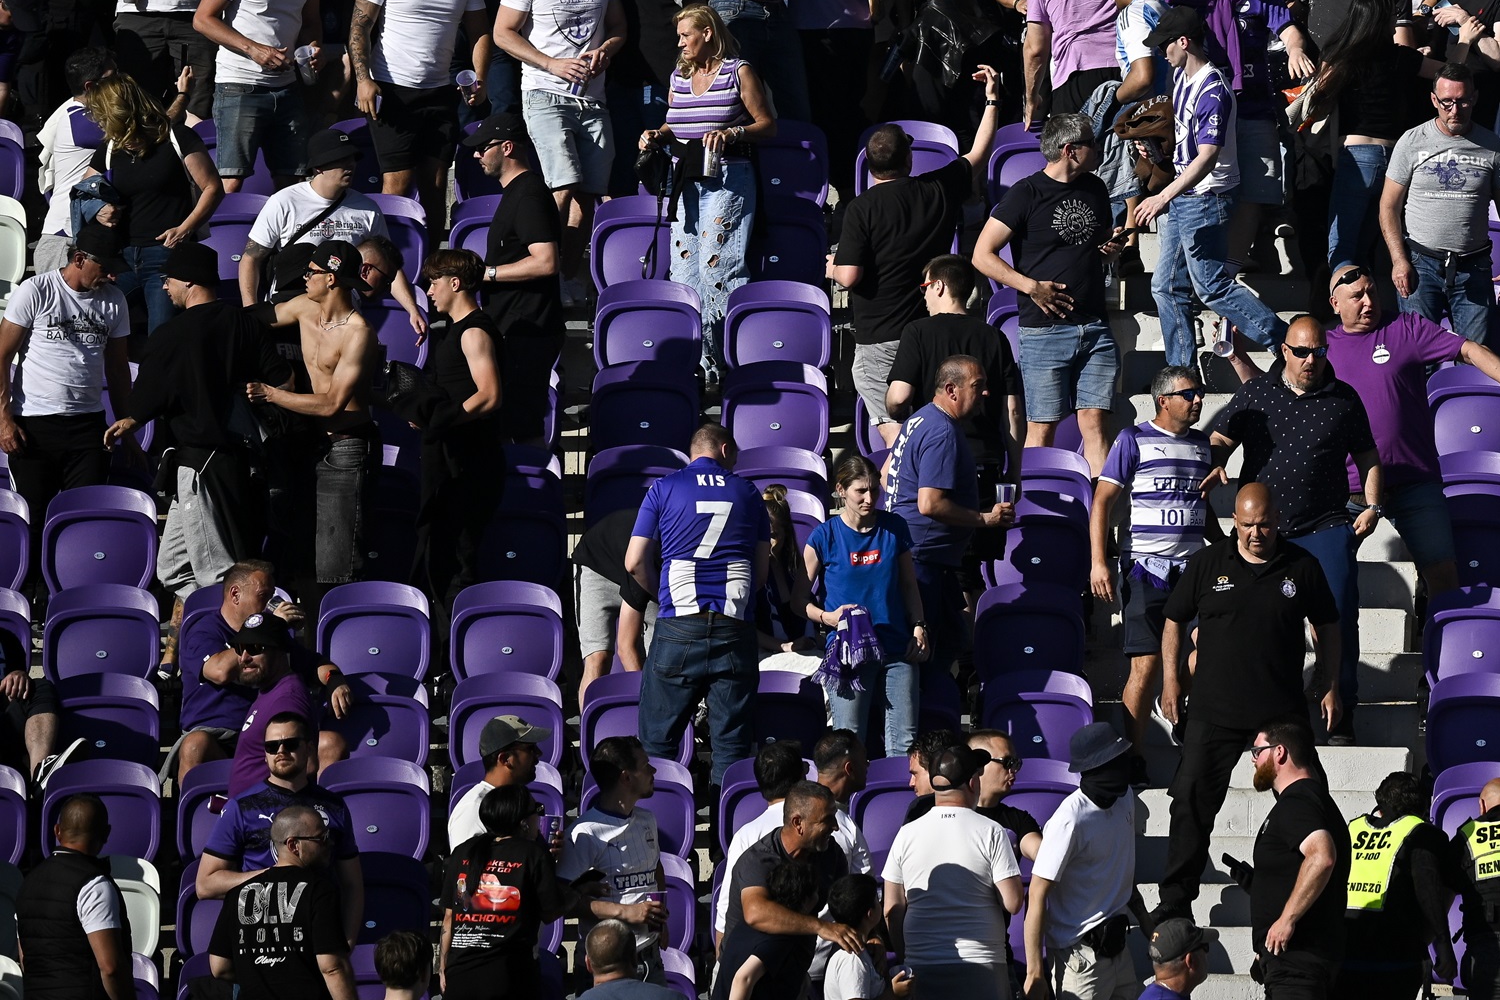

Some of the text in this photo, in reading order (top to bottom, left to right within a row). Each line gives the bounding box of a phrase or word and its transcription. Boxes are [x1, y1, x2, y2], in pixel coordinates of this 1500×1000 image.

[1053, 206, 1064, 225] RAW
[1062, 199, 1097, 222] CLASSICS
[696, 474, 726, 487] KIS
[1160, 509, 1184, 526] 101
[694, 500, 734, 559] 7
[853, 552, 879, 564] Super
[1352, 830, 1392, 850] SEC.
[1355, 852, 1381, 861] V-100
[237, 881, 308, 926] OLV
[238, 926, 304, 945] 2015
